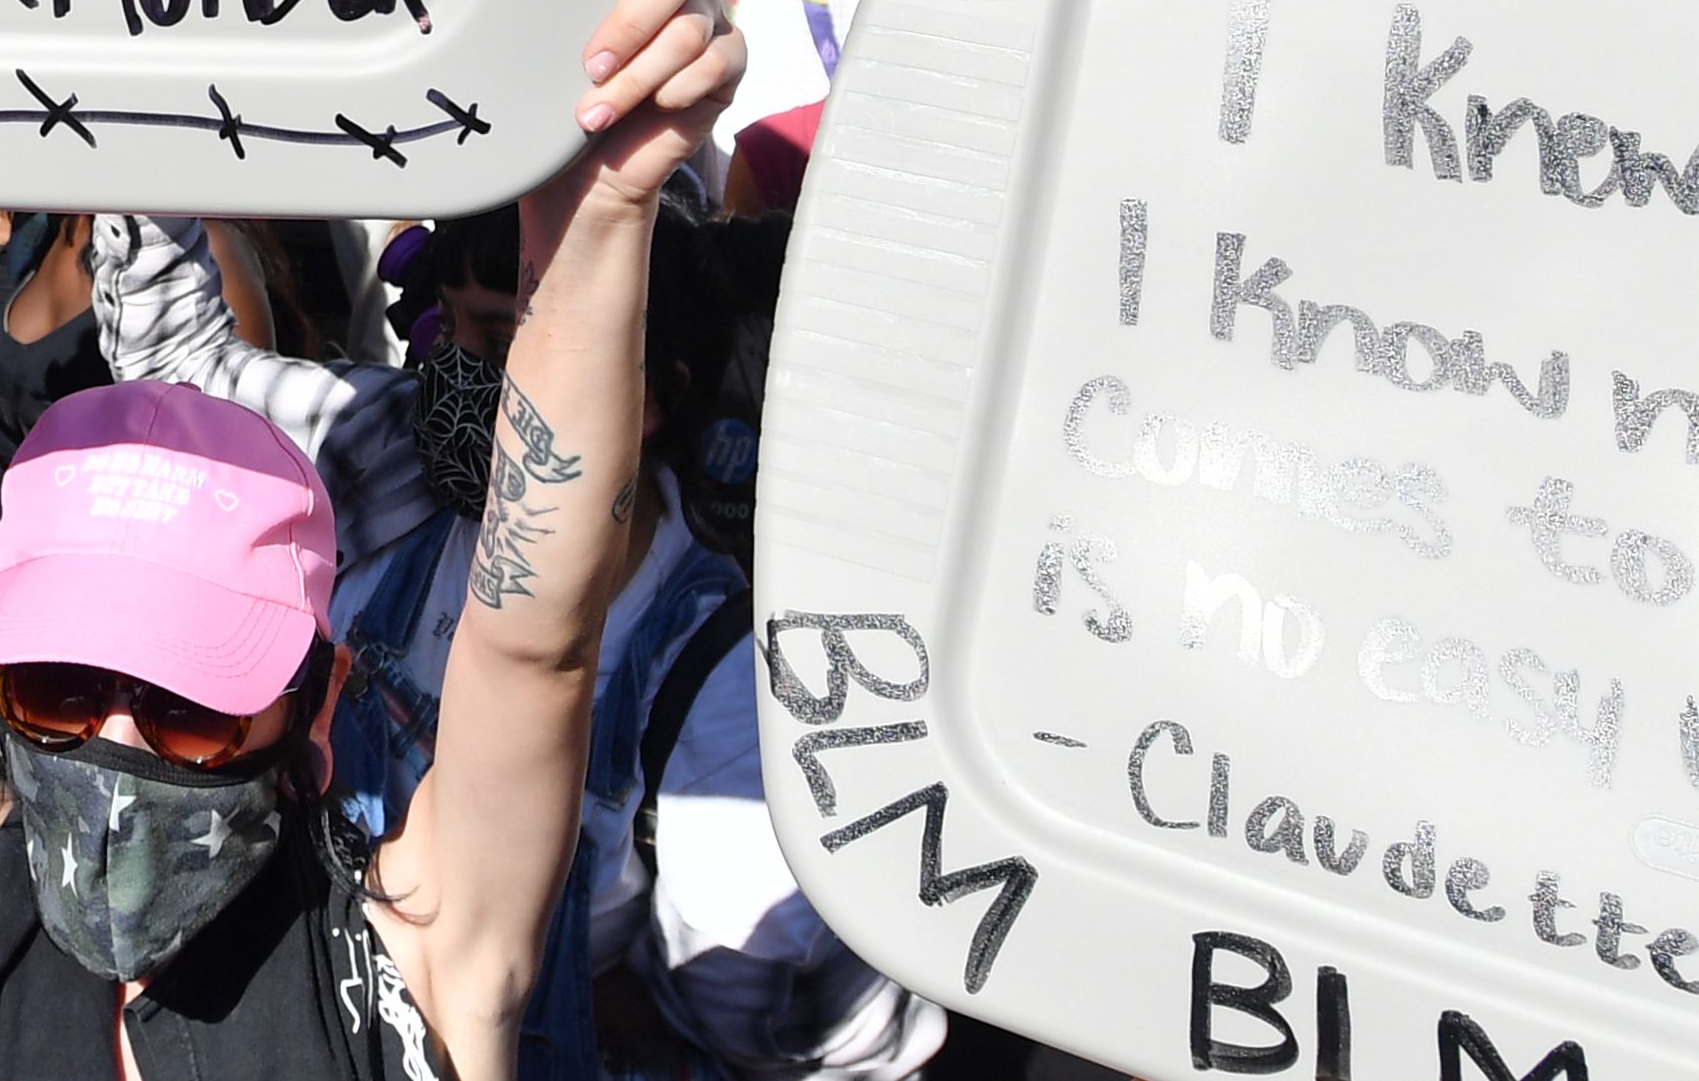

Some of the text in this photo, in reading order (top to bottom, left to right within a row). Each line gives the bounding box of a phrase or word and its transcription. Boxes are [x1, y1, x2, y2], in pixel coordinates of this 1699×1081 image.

[1119, 198, 1148, 326] I
[1033, 514, 1133, 643] is
[1180, 559, 1326, 681] no
[1356, 617, 1626, 791] easy
[1505, 475, 1696, 606] to
[765, 610, 1038, 995] BLM
[1128, 720, 1699, 996] Claudette
